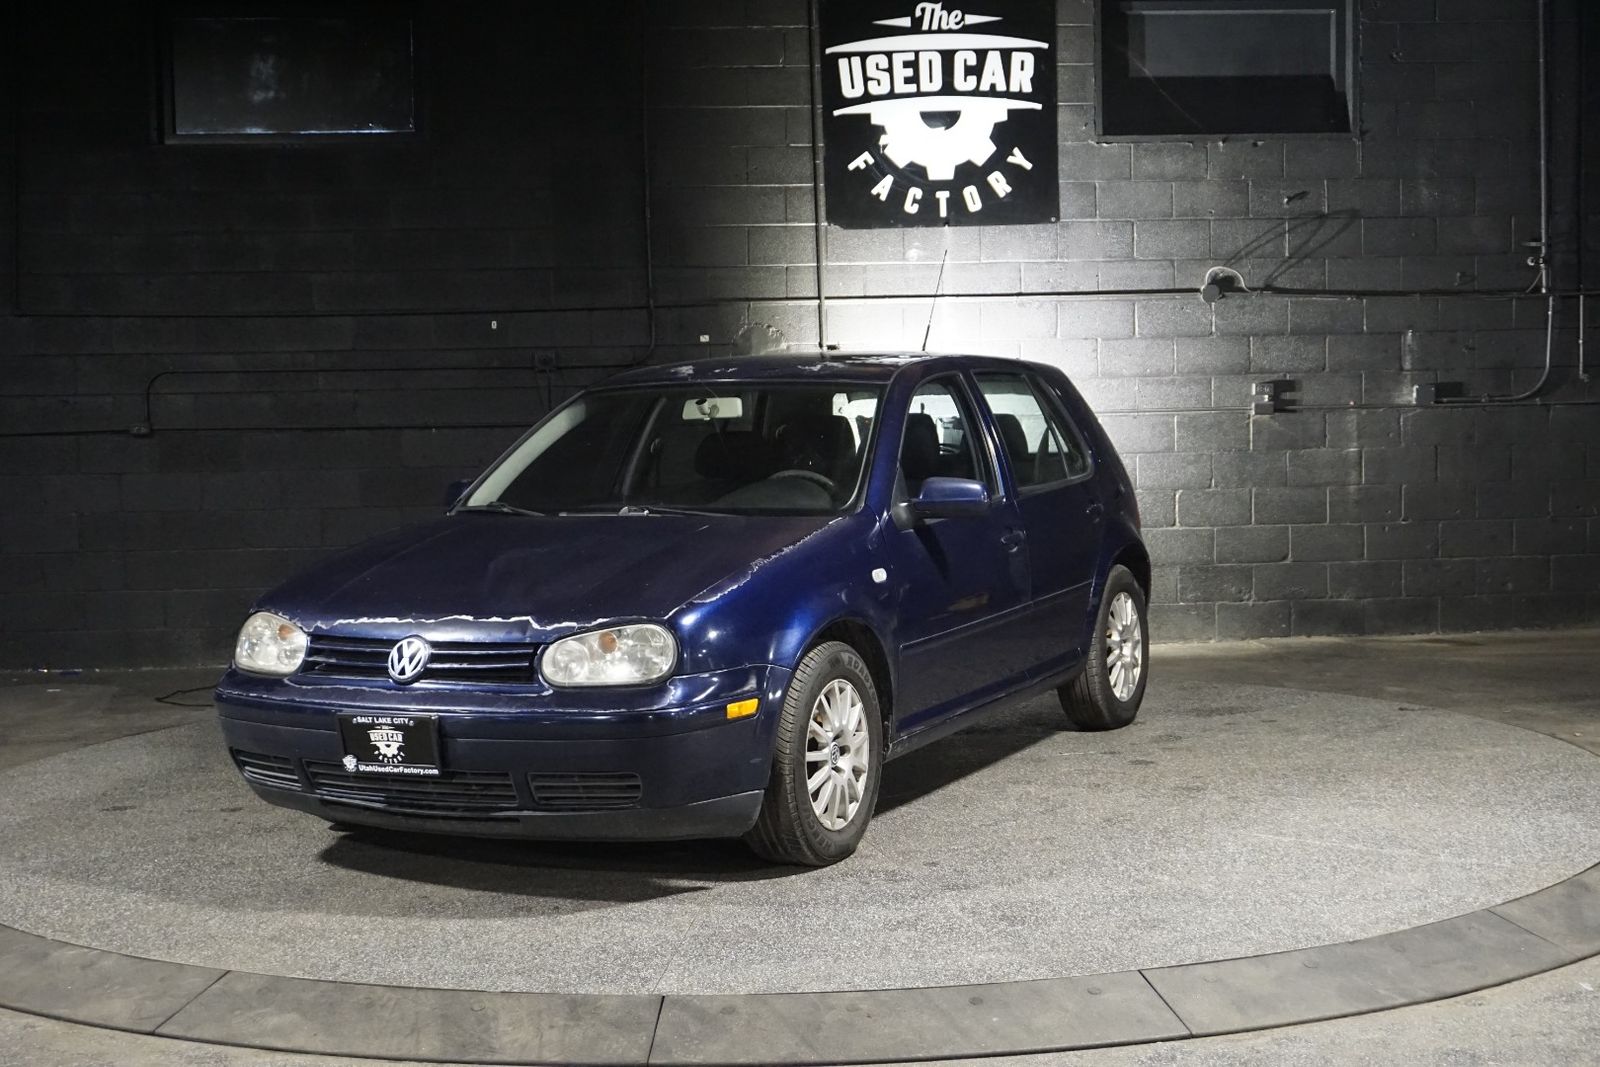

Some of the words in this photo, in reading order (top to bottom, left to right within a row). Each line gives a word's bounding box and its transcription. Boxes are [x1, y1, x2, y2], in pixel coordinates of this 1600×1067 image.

[915, 2, 965, 31] The
[838, 51, 943, 98] USED
[953, 50, 1035, 93] CAR
[847, 147, 1033, 218] FACTORY
[393, 717, 409, 725] CITY
